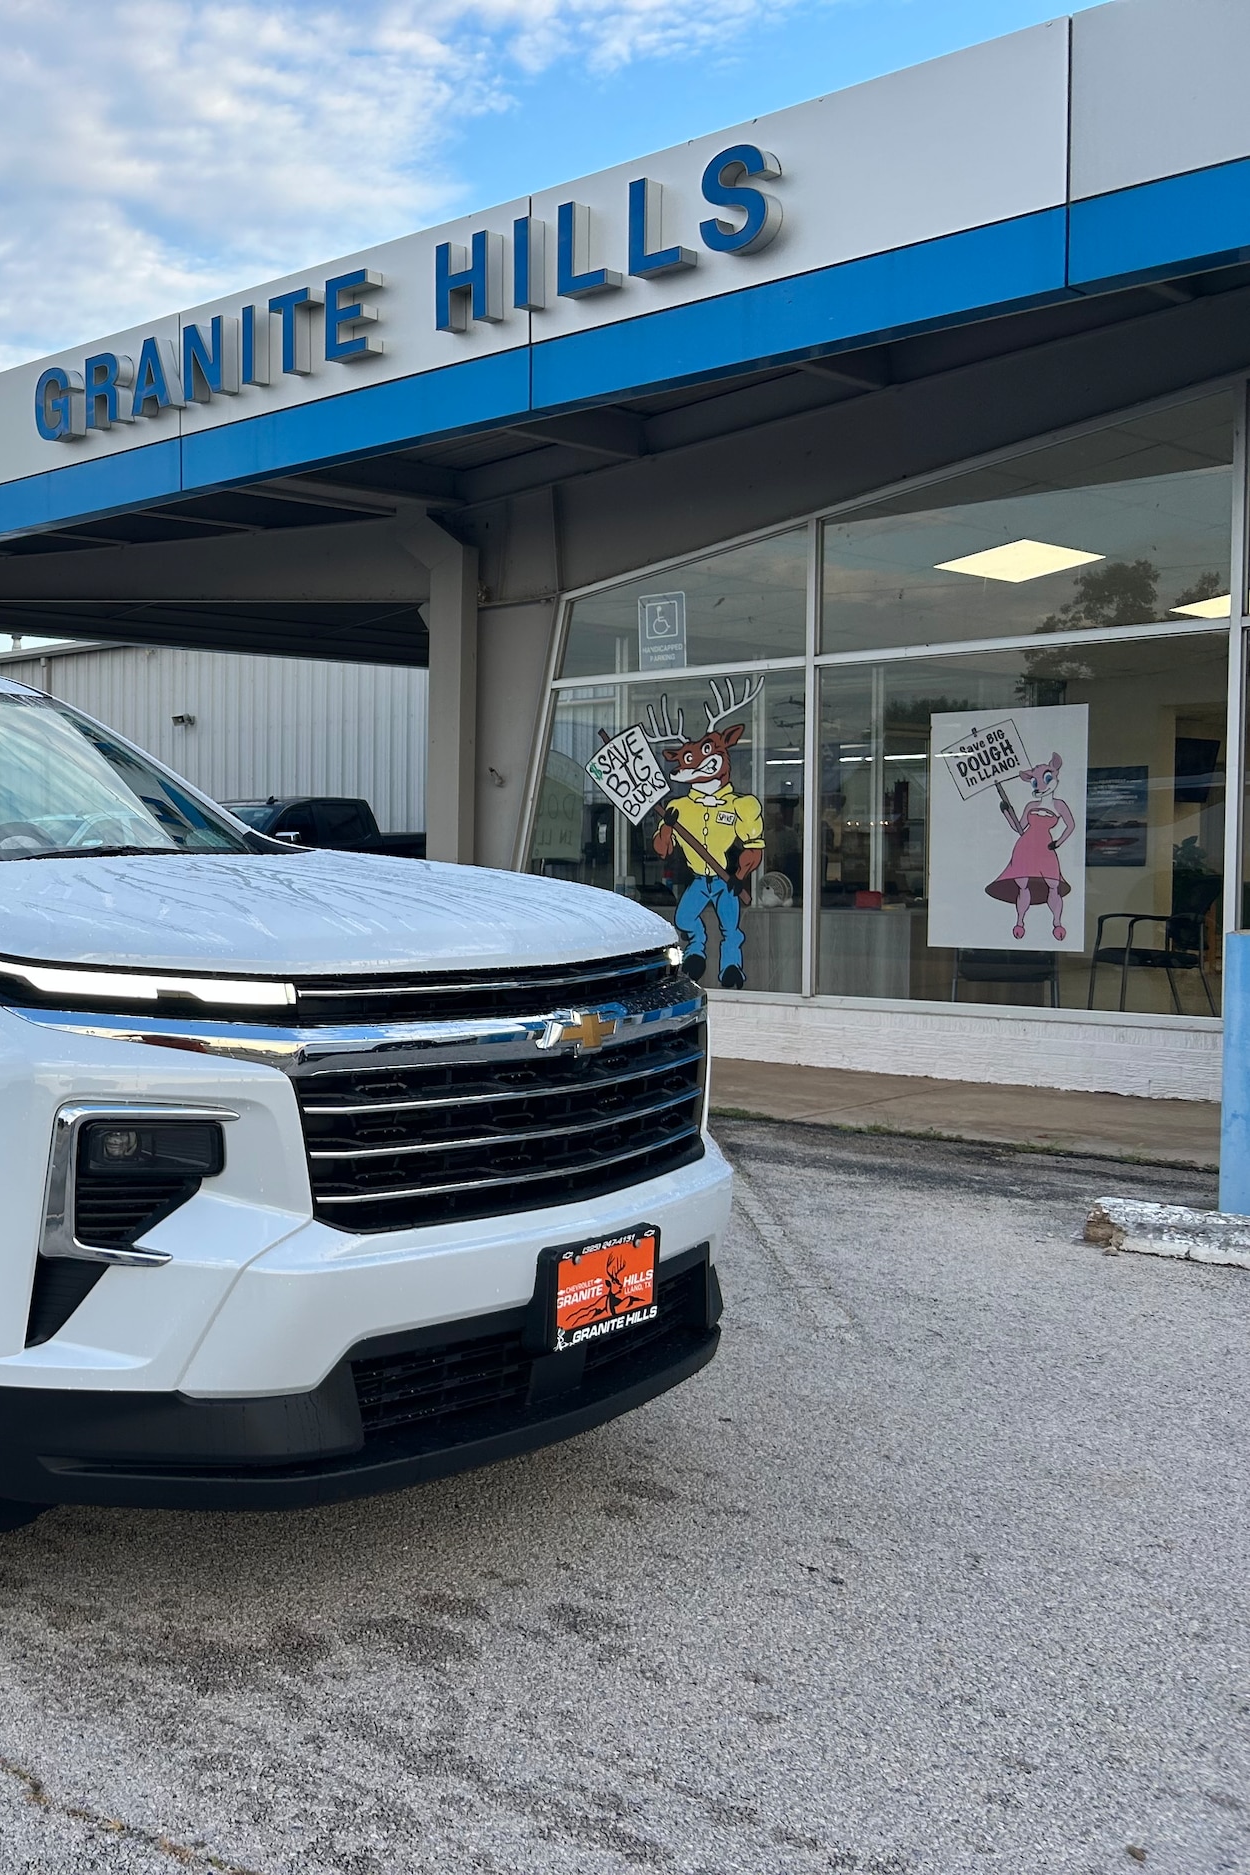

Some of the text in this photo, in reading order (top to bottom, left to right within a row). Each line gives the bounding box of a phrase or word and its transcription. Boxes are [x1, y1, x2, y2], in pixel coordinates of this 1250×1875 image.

[34, 144, 783, 442] GRANITE HILLS
[642, 643, 683, 654] HANDICAPPED
[650, 653, 676, 662] PARKING
[985, 729, 1005, 745] BIG
[606, 754, 651, 798] BIG
[956, 738, 1015, 778] DOUGH
[977, 754, 1021, 782] LLANO!
[622, 771, 667, 818] BUCKS
[557, 1269, 654, 1309] GRANITE HILLS
[565, 1279, 595, 1295] CHEVROLET
[572, 1305, 658, 1344] GRANITE HILLS
